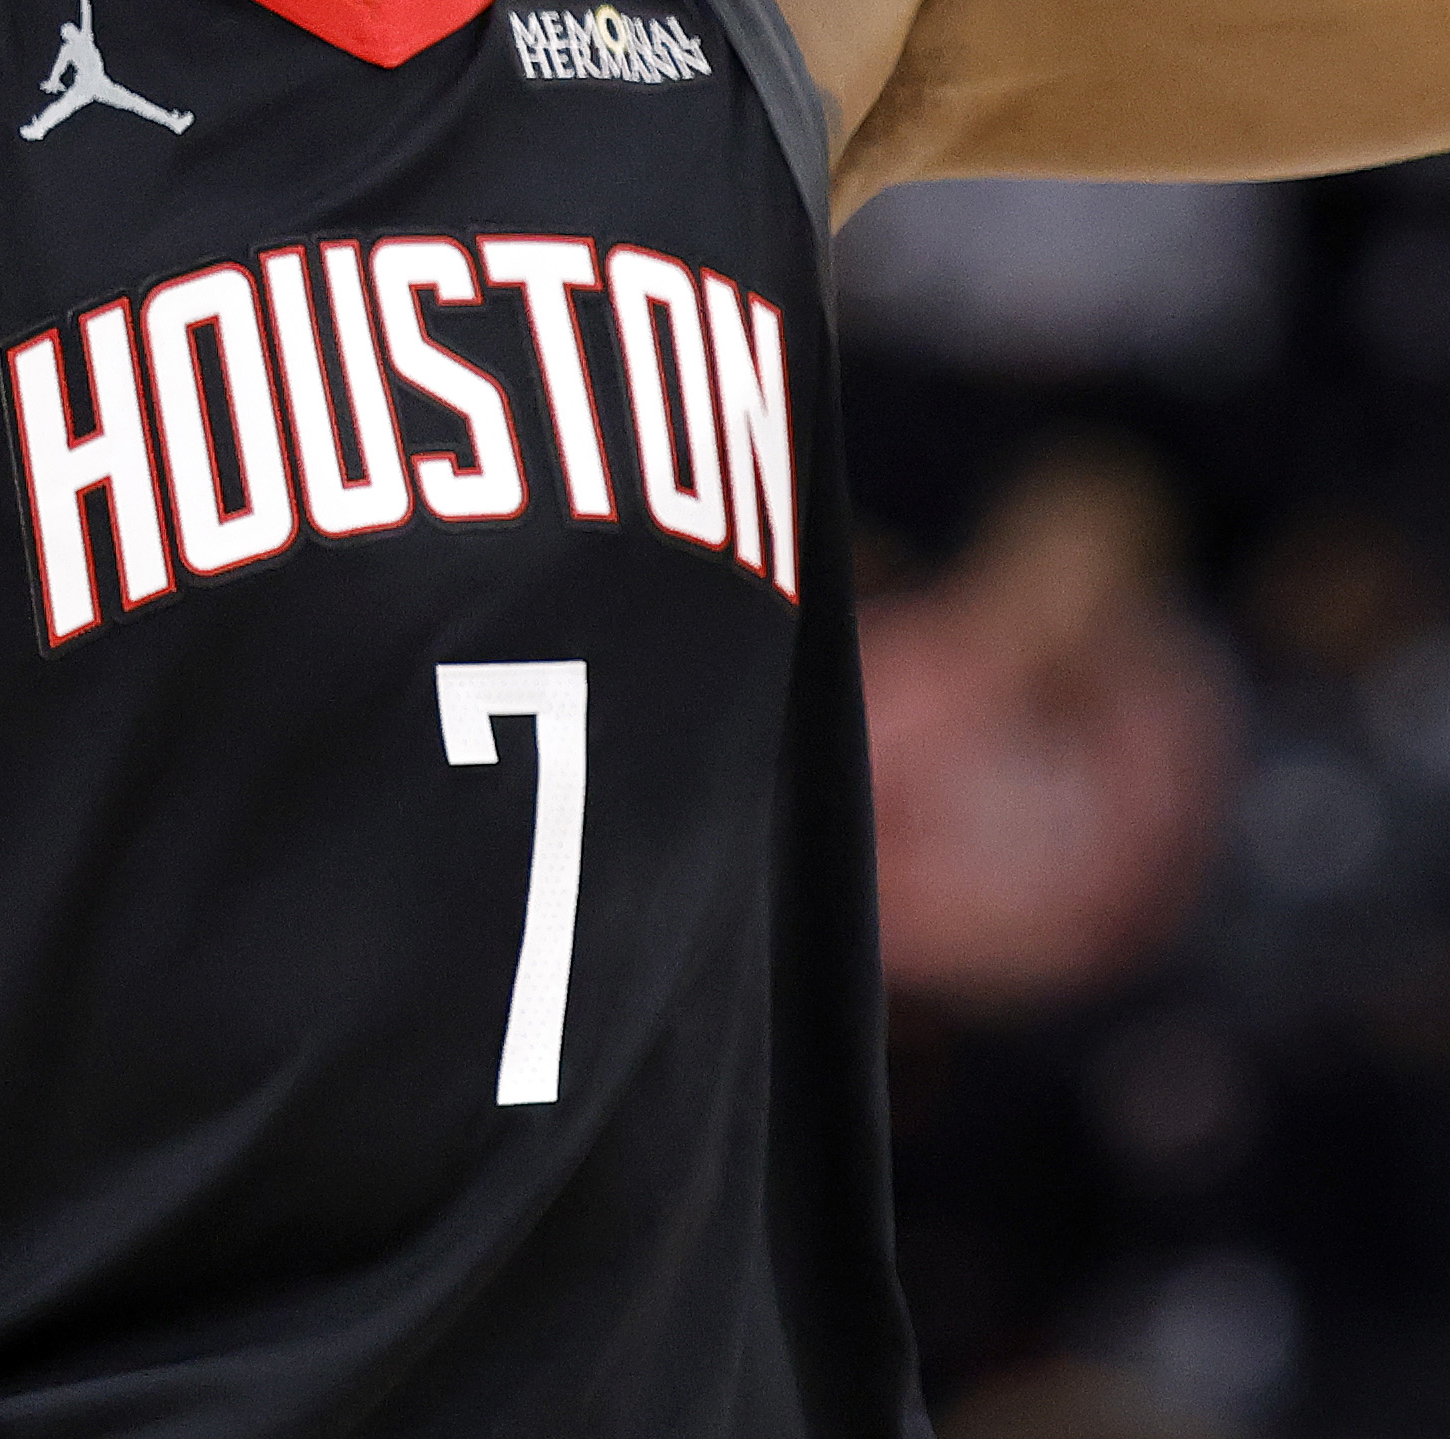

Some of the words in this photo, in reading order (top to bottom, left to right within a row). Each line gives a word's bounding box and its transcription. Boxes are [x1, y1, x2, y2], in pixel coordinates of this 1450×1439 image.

[507, 4, 701, 53] MEMORIAL
[517, 41, 712, 83] HERMANN
[7, 234, 799, 648] HOUSTON
[435, 660, 588, 1107] 7
